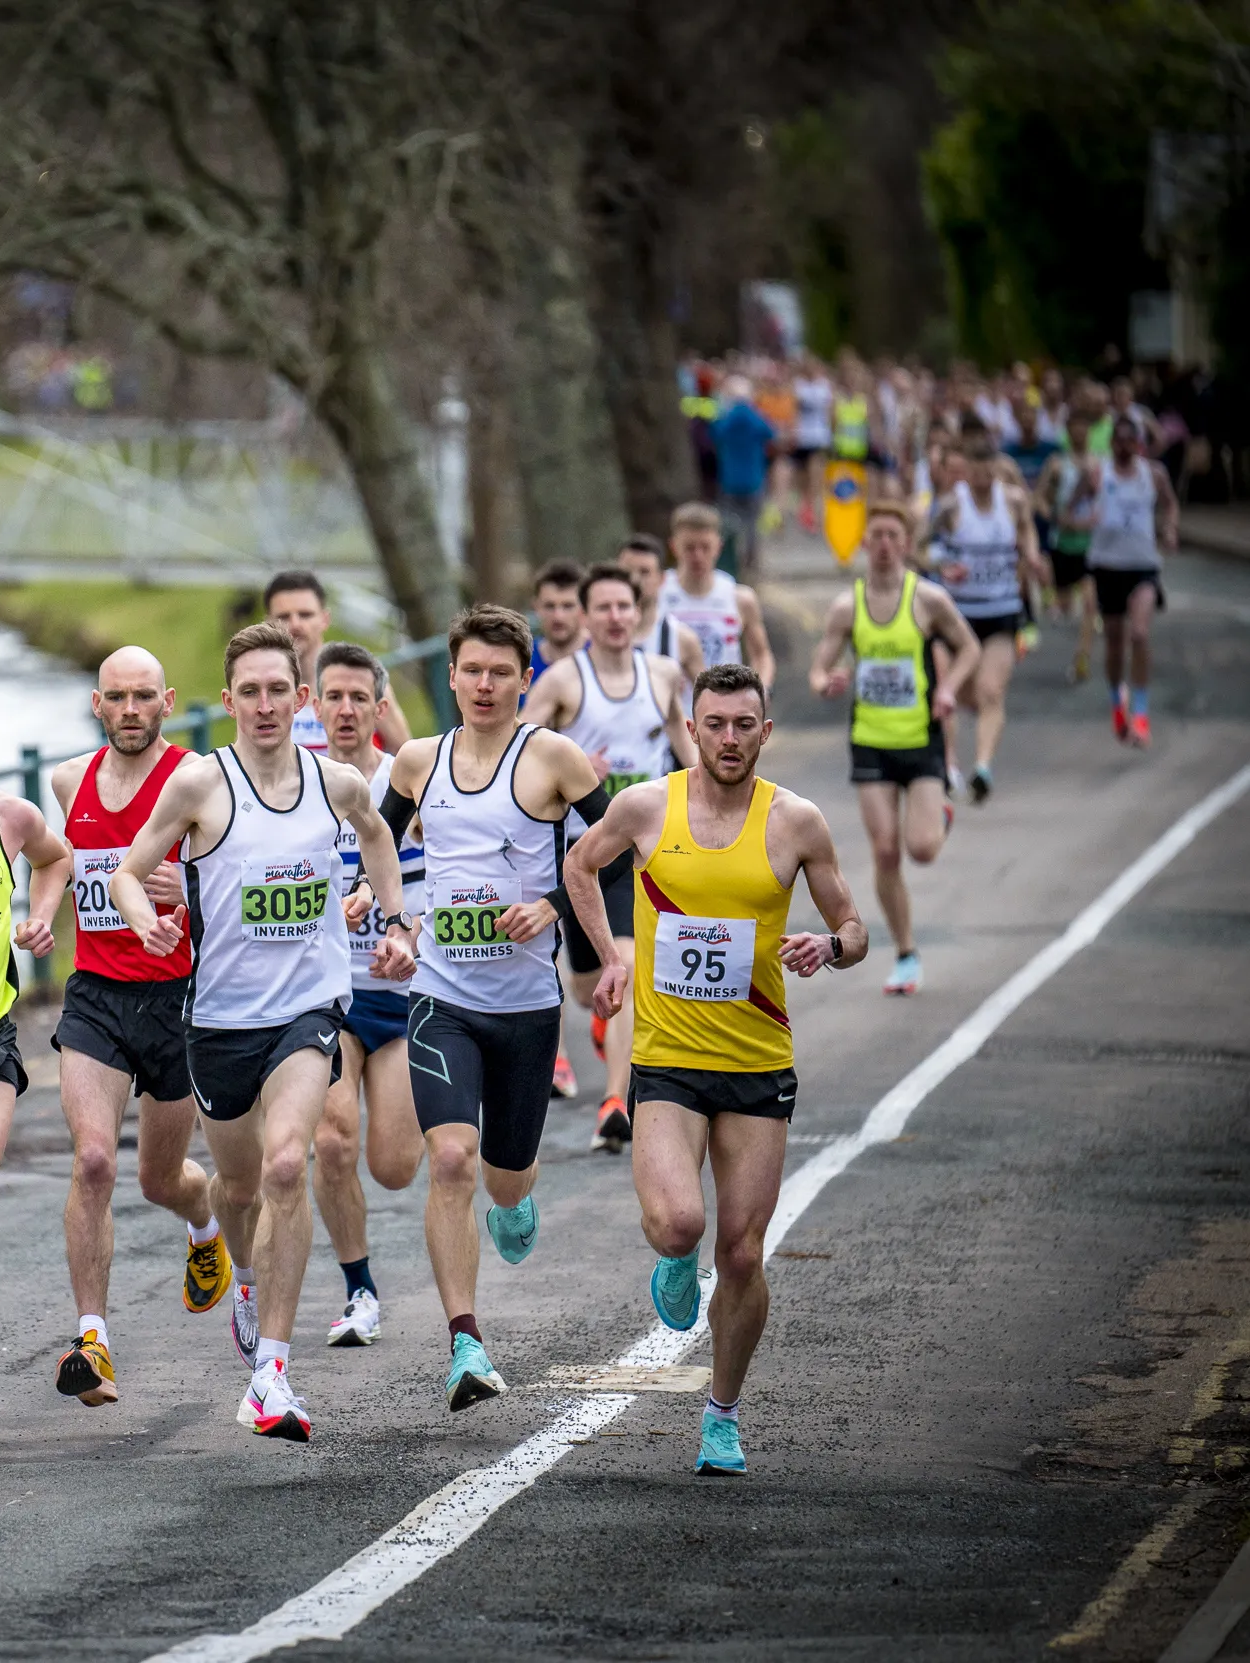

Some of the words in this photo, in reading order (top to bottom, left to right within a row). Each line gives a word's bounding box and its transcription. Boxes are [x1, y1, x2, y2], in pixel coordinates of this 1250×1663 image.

[265, 862, 314, 881] marathon
[77, 880, 118, 912] 20
[245, 882, 328, 922] 3055
[451, 886, 499, 904] marathon
[83, 916, 126, 927] INVERN
[254, 921, 318, 937] INVERNESS
[437, 908, 511, 943] 330
[678, 926, 731, 944] marathon
[445, 945, 513, 959] INVERNESS
[681, 948, 726, 983] 95
[665, 982, 738, 998] INVERNESS
